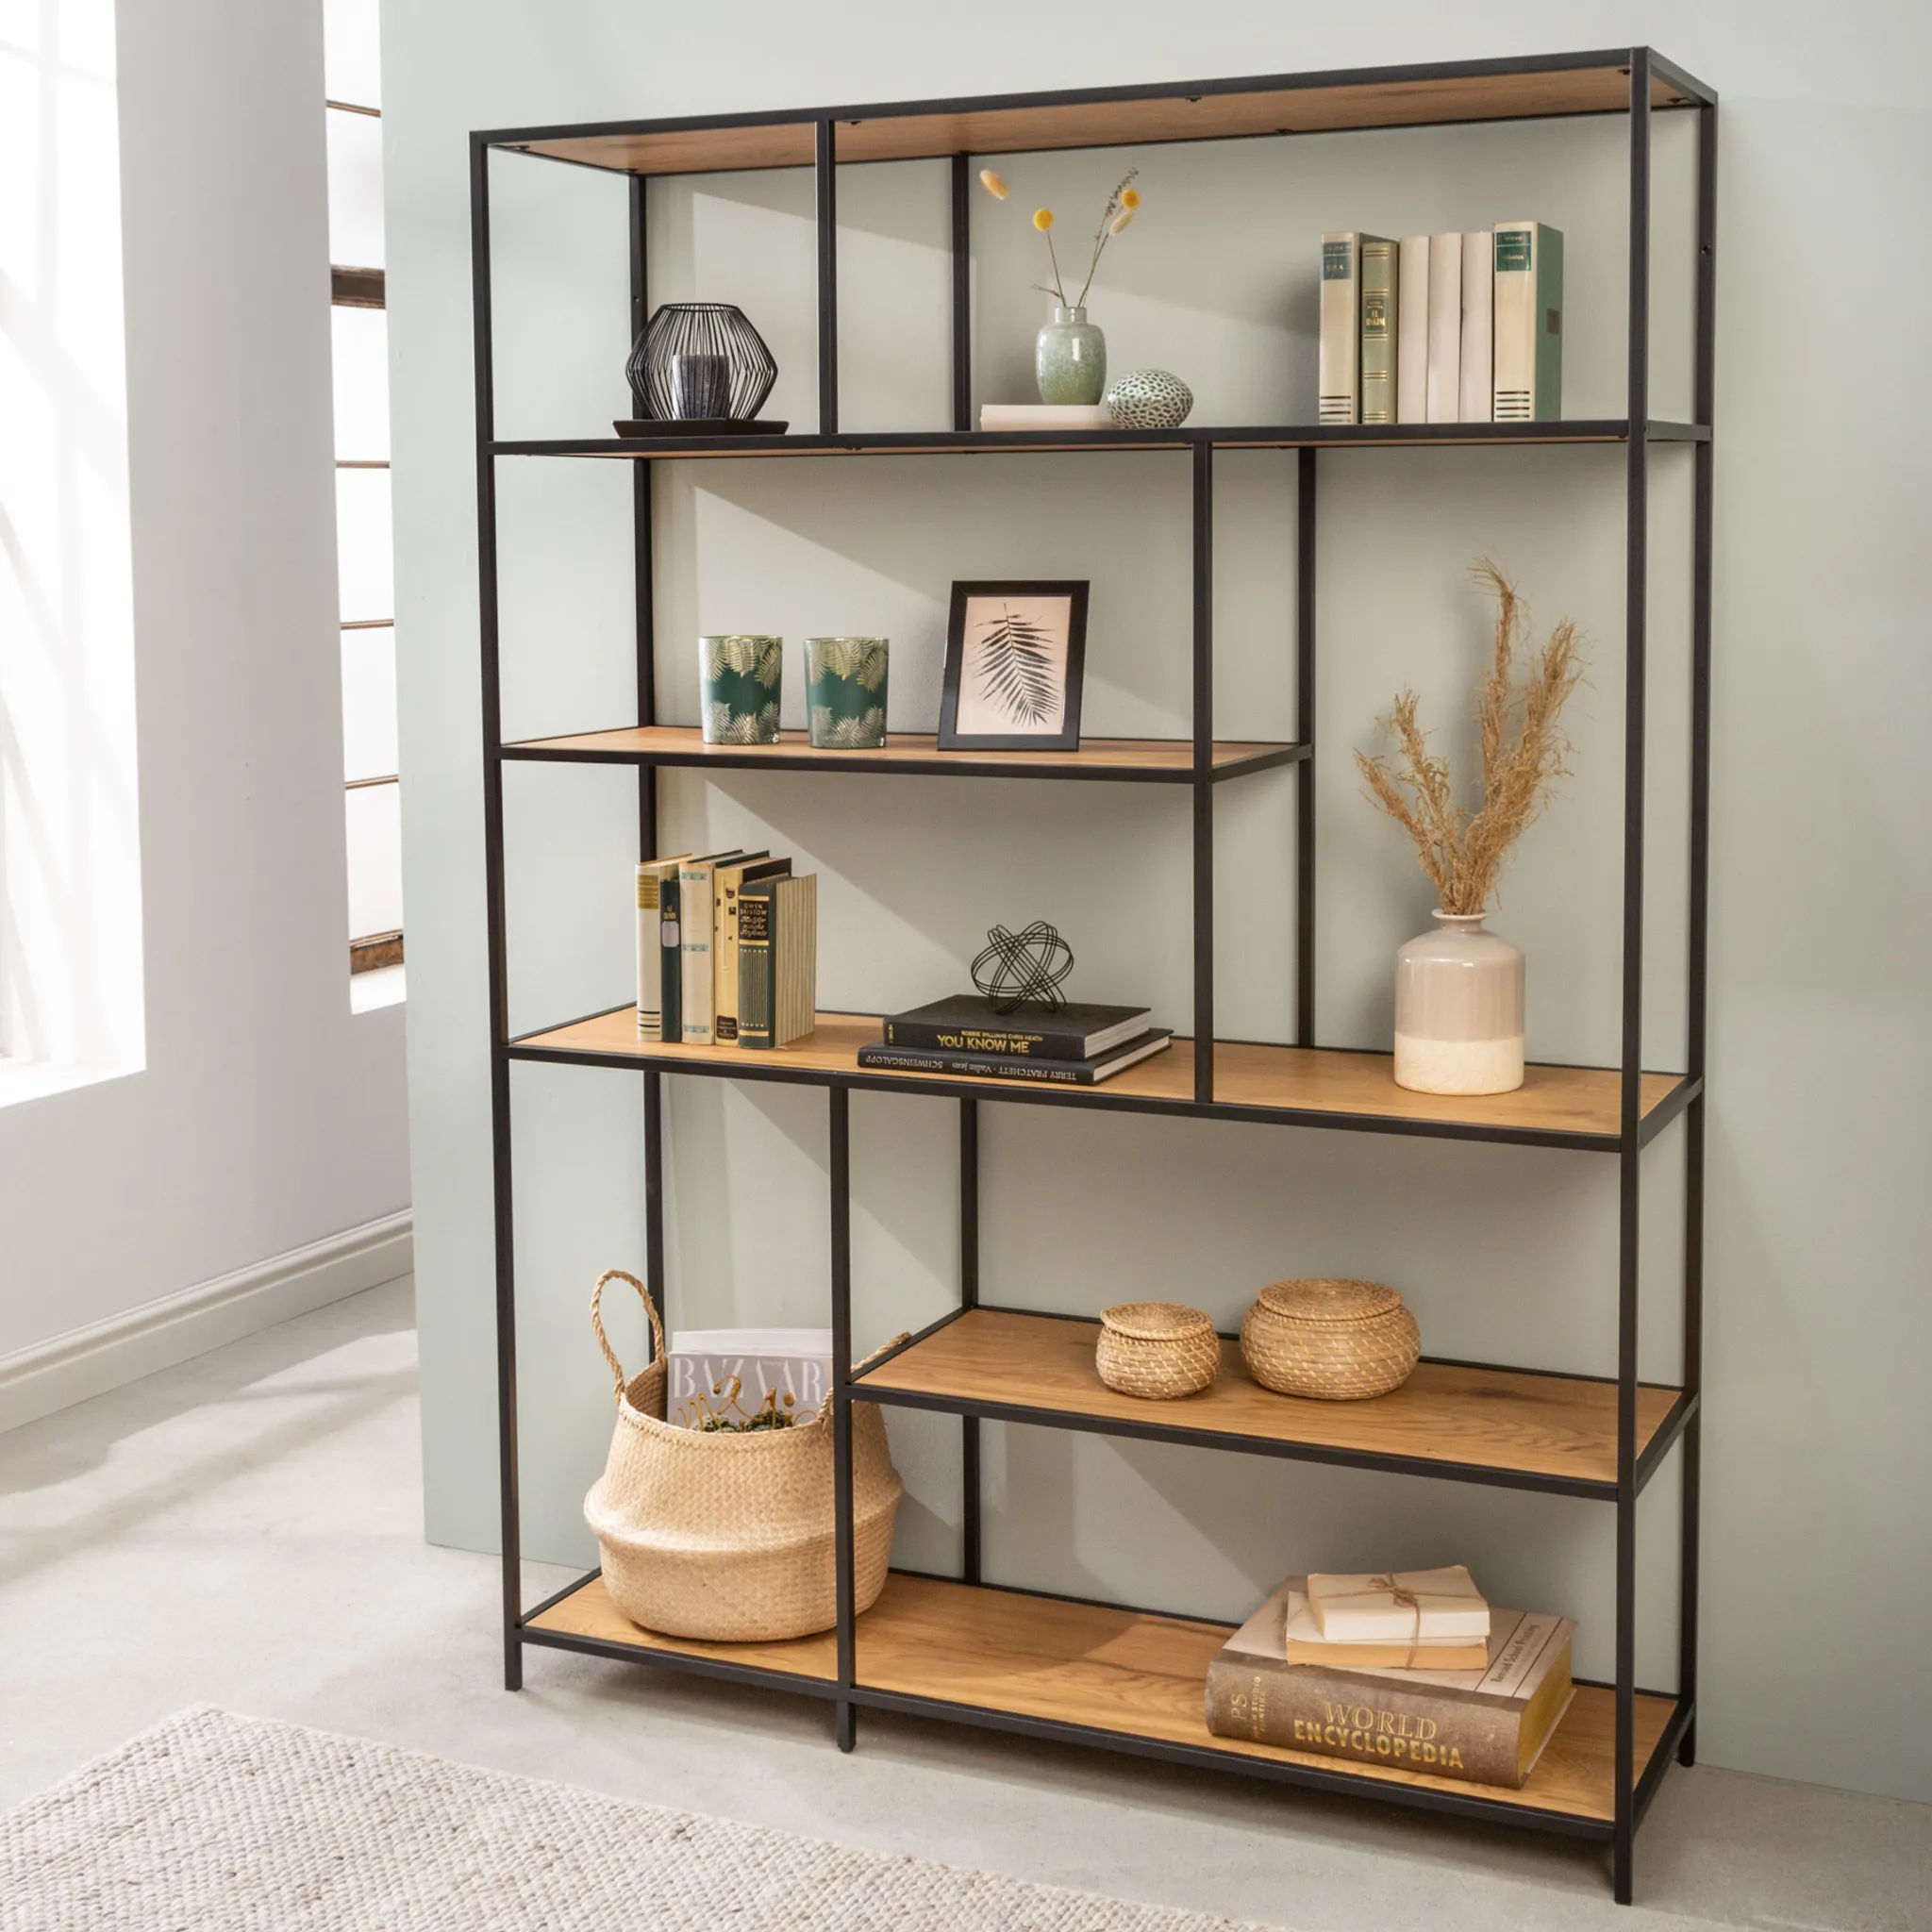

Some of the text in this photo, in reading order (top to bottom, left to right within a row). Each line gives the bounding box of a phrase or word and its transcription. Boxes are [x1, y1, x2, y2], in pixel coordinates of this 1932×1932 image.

[937, 1034, 1030, 1054] YOU KNOW ME
[982, 1031, 1007, 1040] WILLIAMS
[865, 1055, 943, 1069] SCHWEINSGALOPP
[998, 1066, 1048, 1078] PRATCHETT
[1049, 1071, 1077, 1081] TERRY
[674, 1357, 823, 1404] BAZAAR
[1324, 1701, 1438, 1740] WORLD
[1293, 1719, 1464, 1770] ENCYCLOPEDIA
